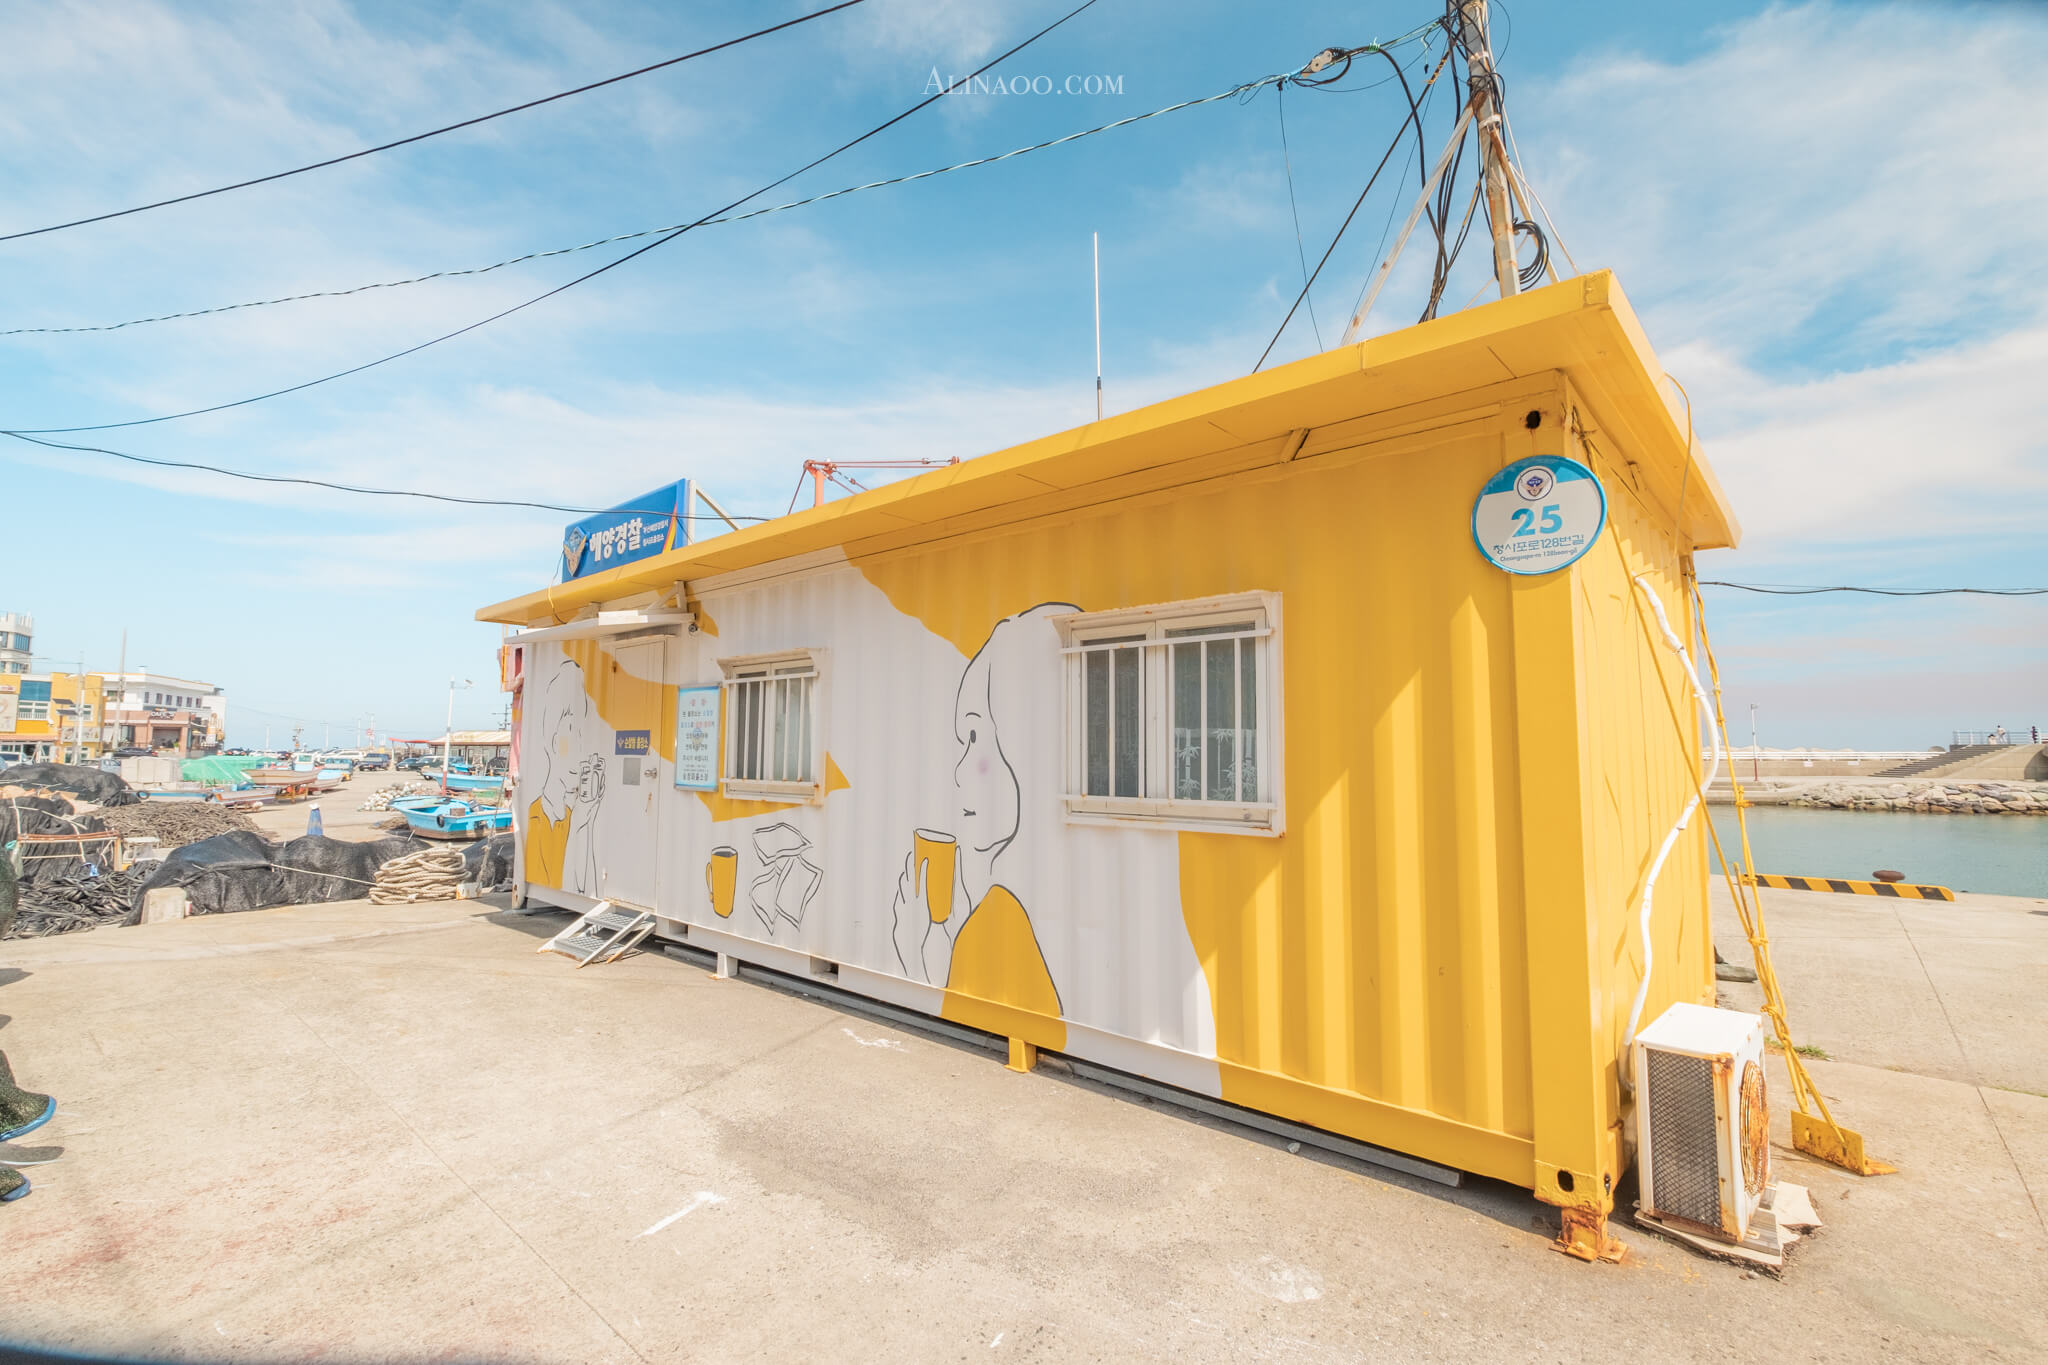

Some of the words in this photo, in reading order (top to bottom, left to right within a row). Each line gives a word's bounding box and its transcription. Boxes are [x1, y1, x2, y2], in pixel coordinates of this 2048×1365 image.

[1511, 504, 1563, 537] 25
[589, 517, 642, 561] 해양경찰
[1493, 534, 1584, 554] 청사포로128번길
